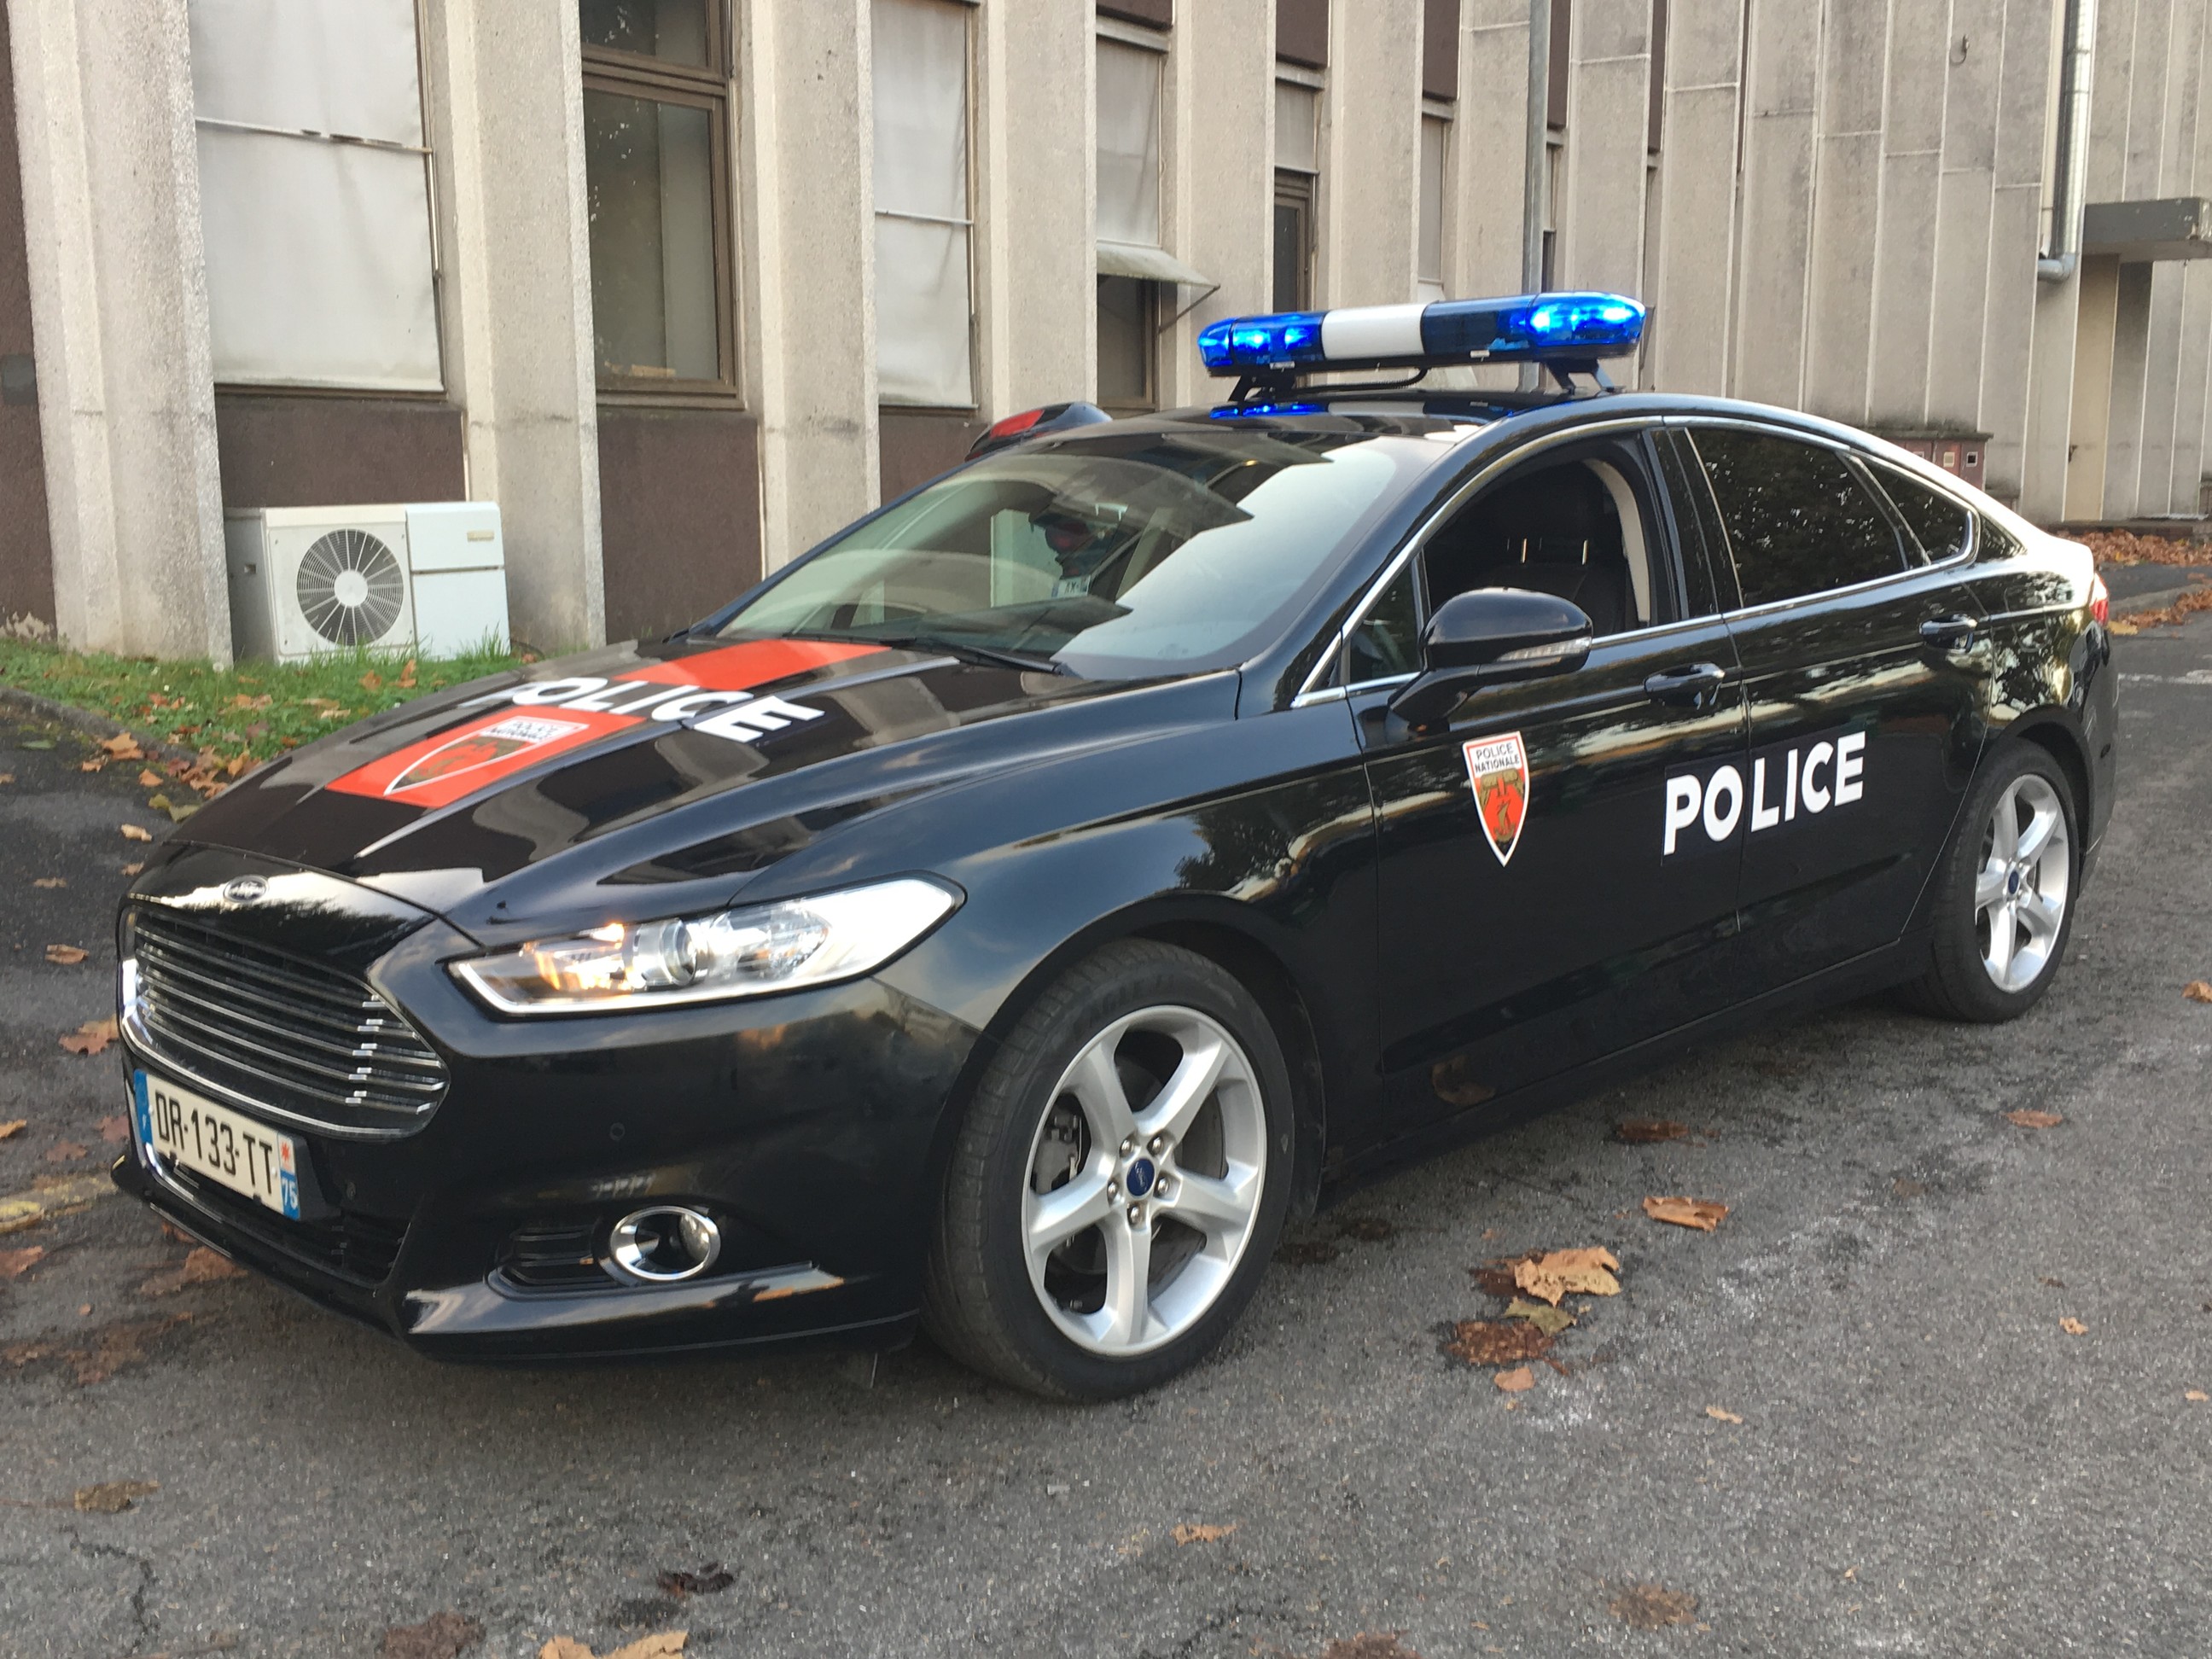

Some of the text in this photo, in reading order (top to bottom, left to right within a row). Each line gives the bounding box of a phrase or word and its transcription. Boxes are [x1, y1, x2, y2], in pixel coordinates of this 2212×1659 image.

[457, 677, 826, 743] POLICE
[1475, 754, 1520, 774] NATIONALE
[1476, 742, 1514, 760] POLICE
[1664, 731, 1866, 856] POLICE
[155, 1090, 273, 1195] DR-133-TT
[282, 1178, 299, 1210] 75
